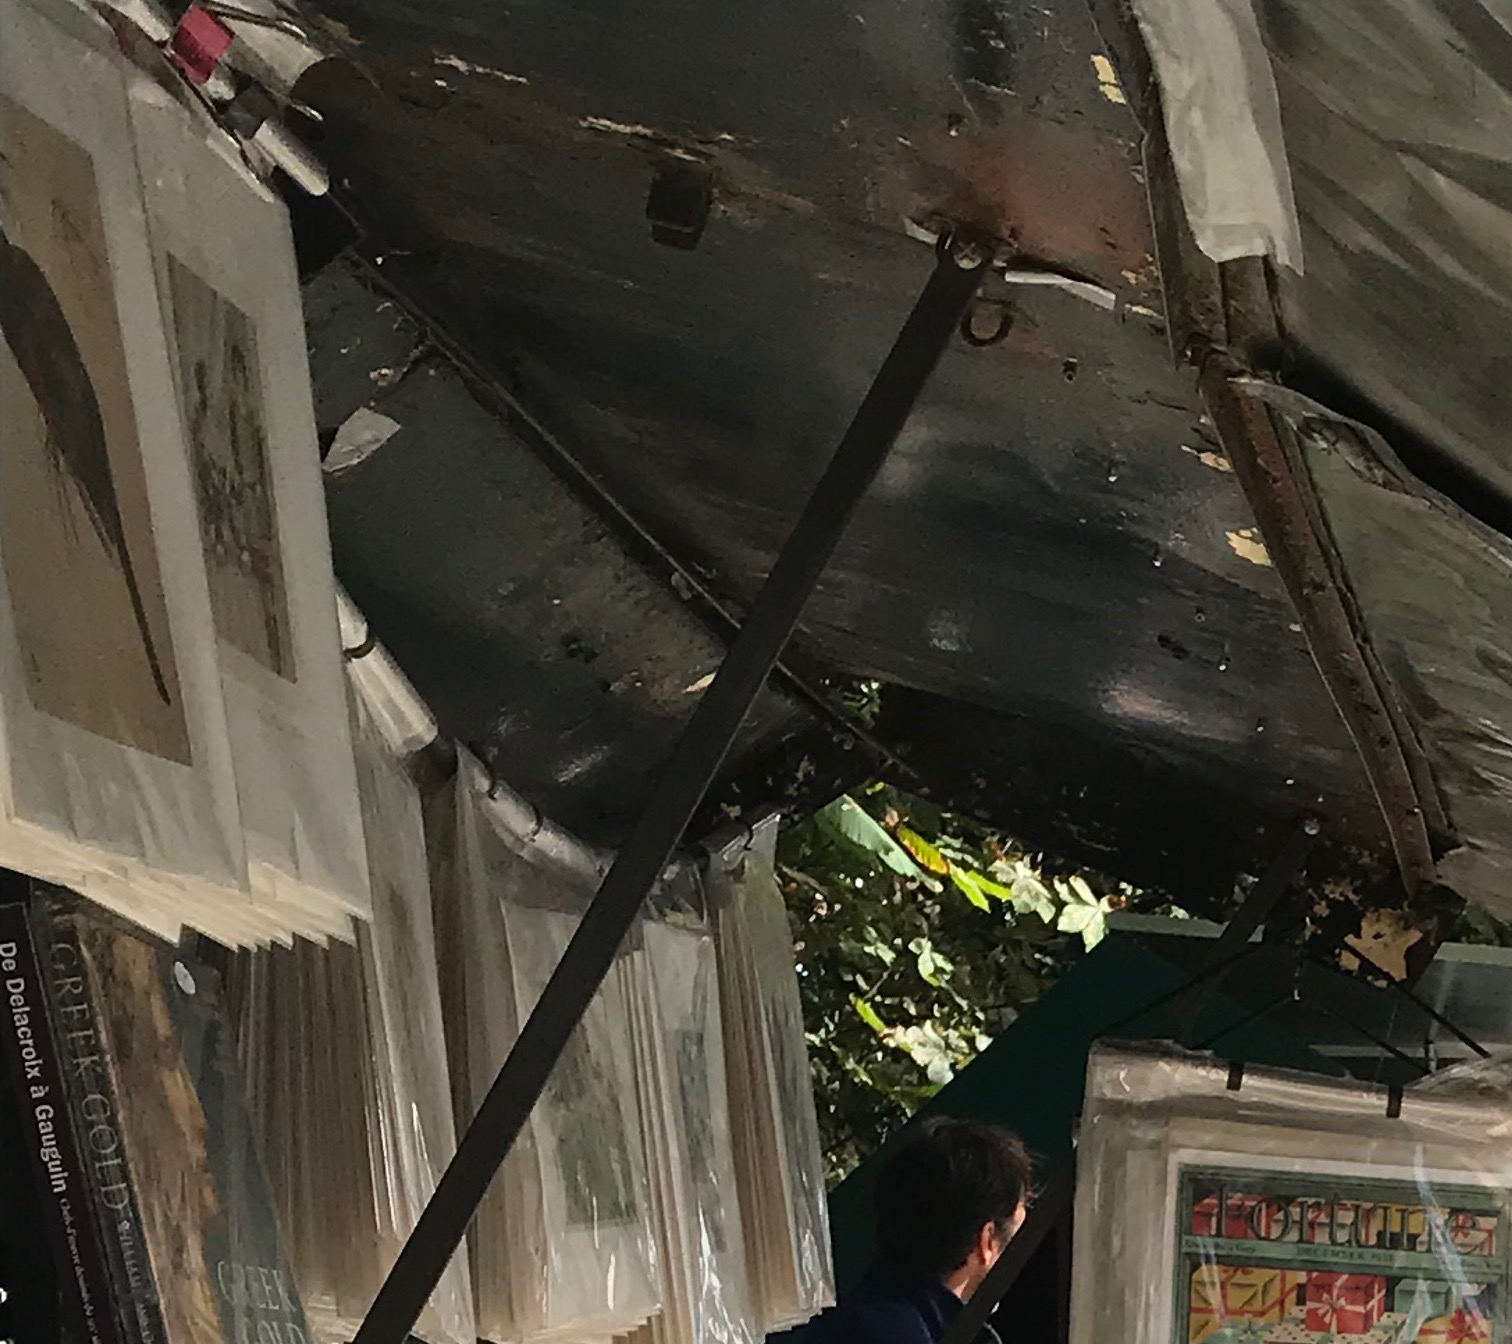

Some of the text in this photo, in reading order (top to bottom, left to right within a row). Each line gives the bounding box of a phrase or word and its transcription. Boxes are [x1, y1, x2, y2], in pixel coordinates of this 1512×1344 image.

[0, 942, 17, 972] De
[6, 977, 44, 1079] Delacroix
[30, 1086, 50, 1099] à
[51, 943, 102, 1077] GREEK
[81, 1092, 130, 1209] GOLD
[34, 1104, 70, 1193] Gauguin
[1211, 1183, 1484, 1255] Fortune
[217, 1261, 297, 1312] GREEK
